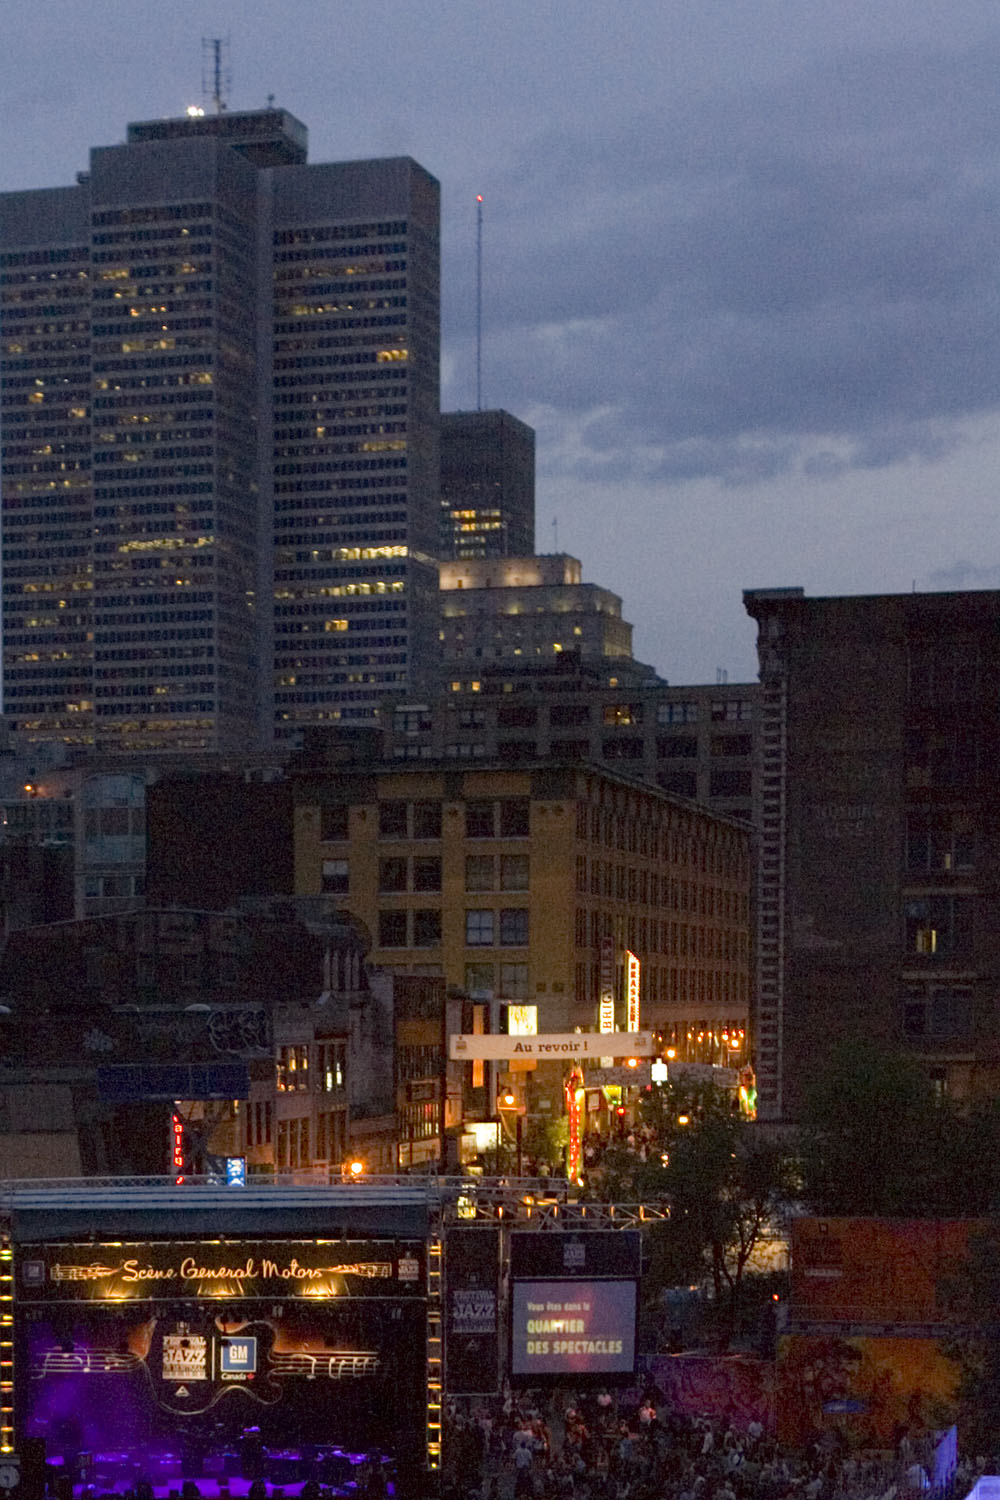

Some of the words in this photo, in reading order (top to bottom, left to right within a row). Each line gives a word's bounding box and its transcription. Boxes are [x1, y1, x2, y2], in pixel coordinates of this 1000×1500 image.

[514, 1043, 532, 1052] Au
[539, 1041, 580, 1052] revoir
[584, 1041, 588, 1051] !
[122, 1260, 175, 1282] Scène
[180, 1257, 257, 1279] General
[262, 1259, 323, 1279] Motors
[527, 1319, 585, 1333] QUARTIER
[230, 1346, 248, 1359] GM
[527, 1341, 549, 1354] DES
[553, 1341, 622, 1354] SPECTACLES
[163, 1349, 206, 1365] JAZZ
